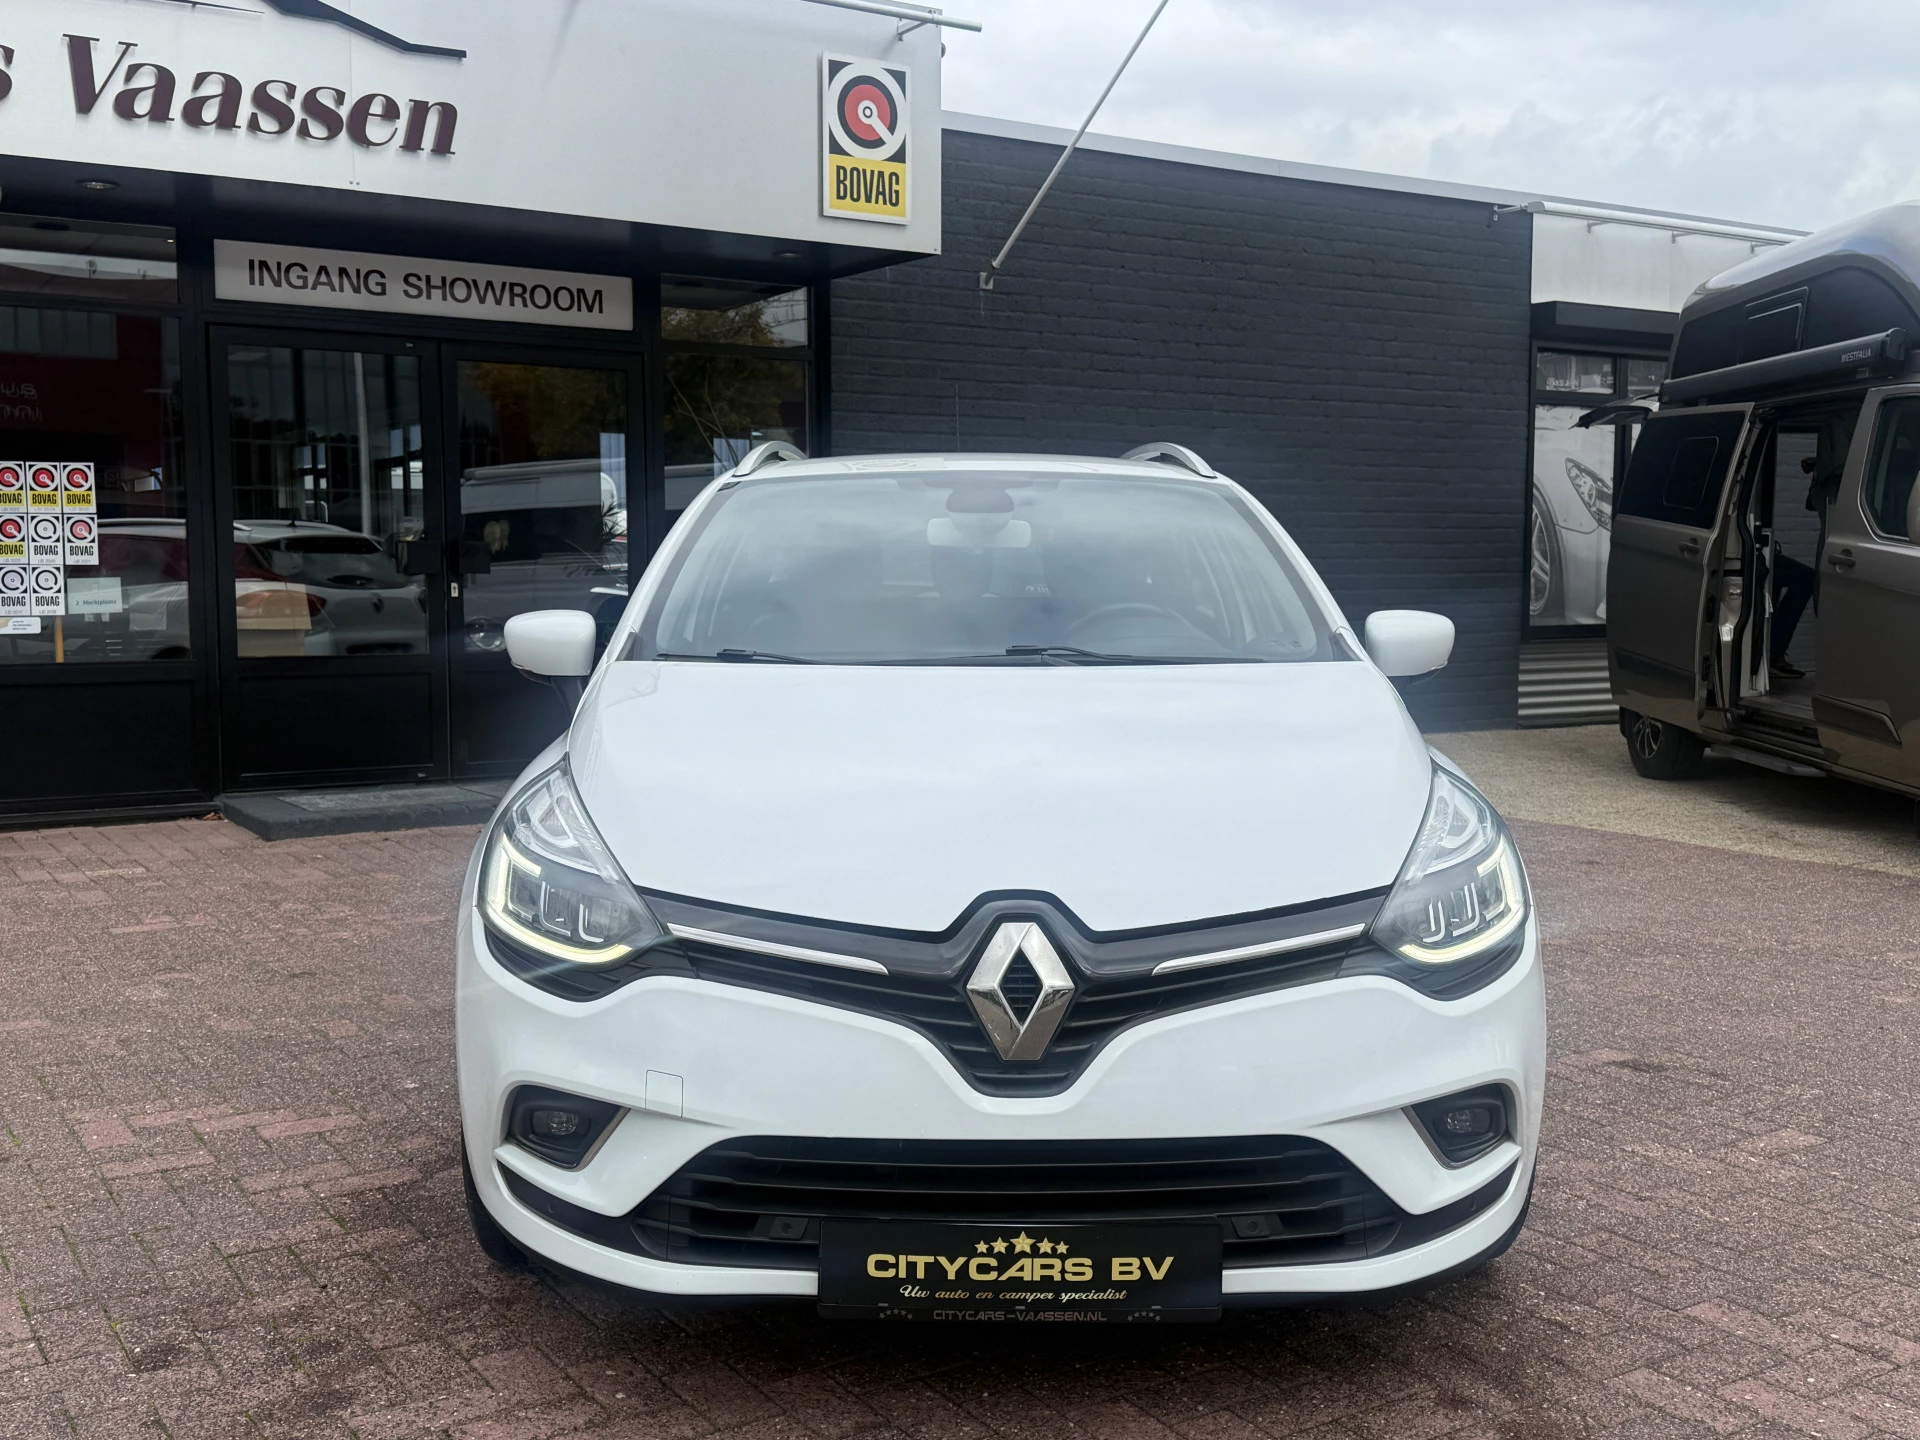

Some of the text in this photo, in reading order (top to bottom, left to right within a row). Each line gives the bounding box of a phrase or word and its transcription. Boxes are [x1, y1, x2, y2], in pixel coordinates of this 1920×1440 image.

[62, 33, 458, 155] Vaassen
[836, 165, 900, 207] BOVAG
[248, 259, 604, 315] INGANG SHOWROOM
[1841, 349, 1872, 362] WESTFALIA
[32, 493, 57, 504] BOVAG
[66, 493, 91, 505] BOVAG
[34, 545, 59, 556] BOVAG
[69, 545, 94, 557] BOVAG
[1, 595, 26, 607] BOVAG
[35, 595, 60, 607] BOVAG
[866, 1253, 1175, 1282] CITYCARS BV
[899, 1284, 1128, 1304] Uw auto en camper specialist
[932, 1309, 1107, 1322] CITYCARS-VAASSEN.NL
